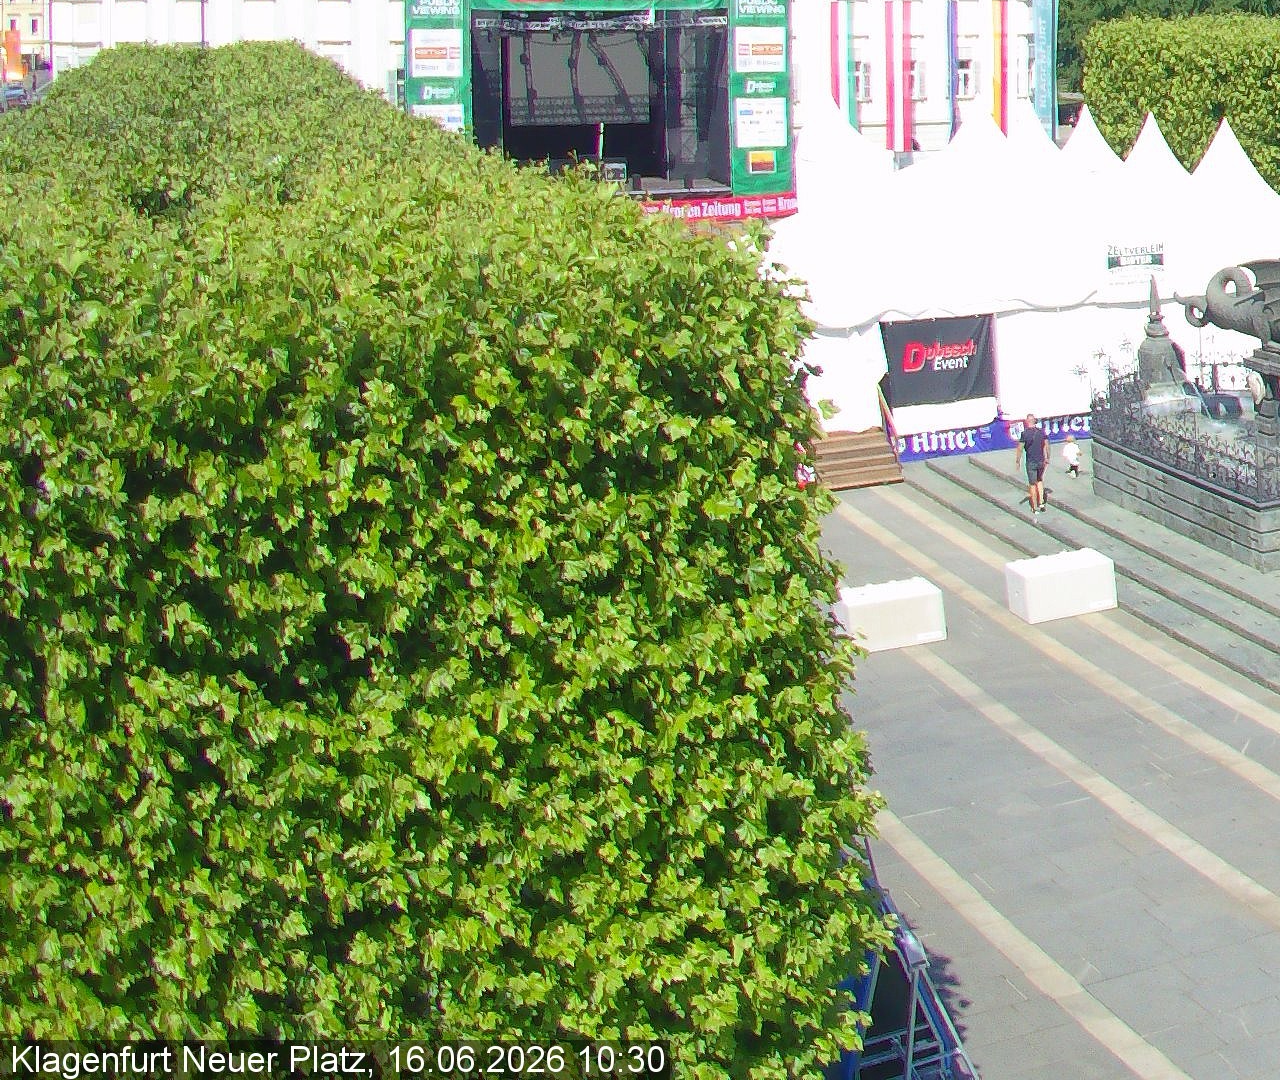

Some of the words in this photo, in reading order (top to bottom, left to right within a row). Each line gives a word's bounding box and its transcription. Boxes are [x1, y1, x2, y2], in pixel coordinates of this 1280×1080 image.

[412, 5, 461, 15] VIEWING
[738, 4, 785, 15] VIEWING
[702, 200, 741, 217] Zeitung
[1107, 241, 1164, 256] ZELTVERLEIH
[934, 356, 969, 371] Event
[912, 429, 977, 453] Hirter
